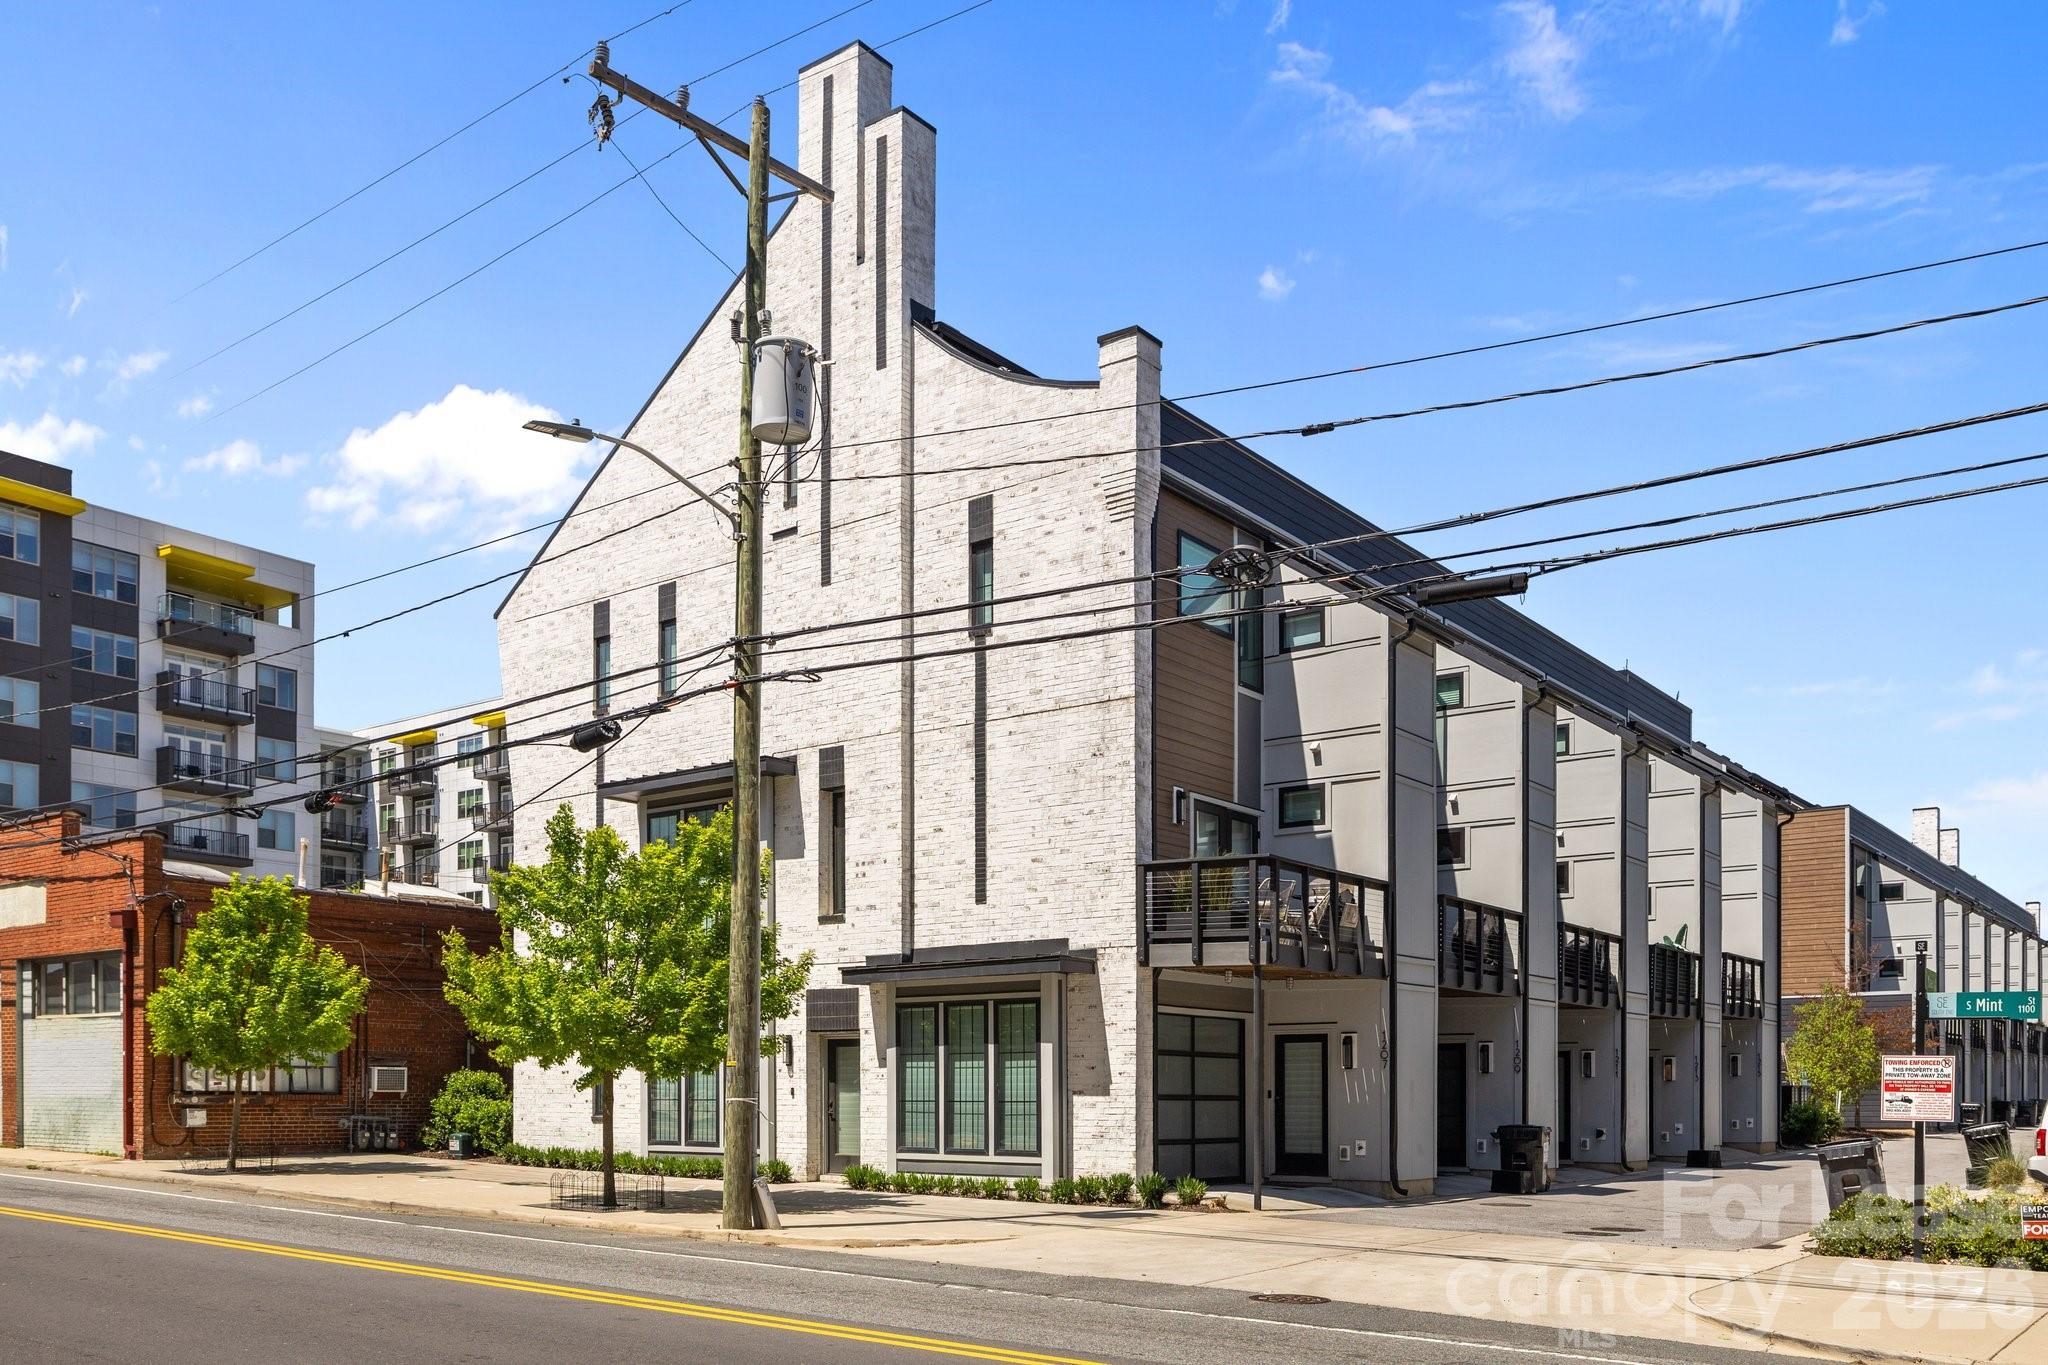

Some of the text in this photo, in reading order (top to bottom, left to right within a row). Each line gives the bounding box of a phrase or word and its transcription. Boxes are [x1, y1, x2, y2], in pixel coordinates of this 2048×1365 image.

[795, 382, 807, 393] 100
[1936, 996, 1948, 1009] SE
[1976, 998, 2003, 1012] Mint
[2028, 996, 2036, 1005] St
[2018, 1004, 2036, 1014] 1100
[1380, 1031, 1389, 1069] 1207
